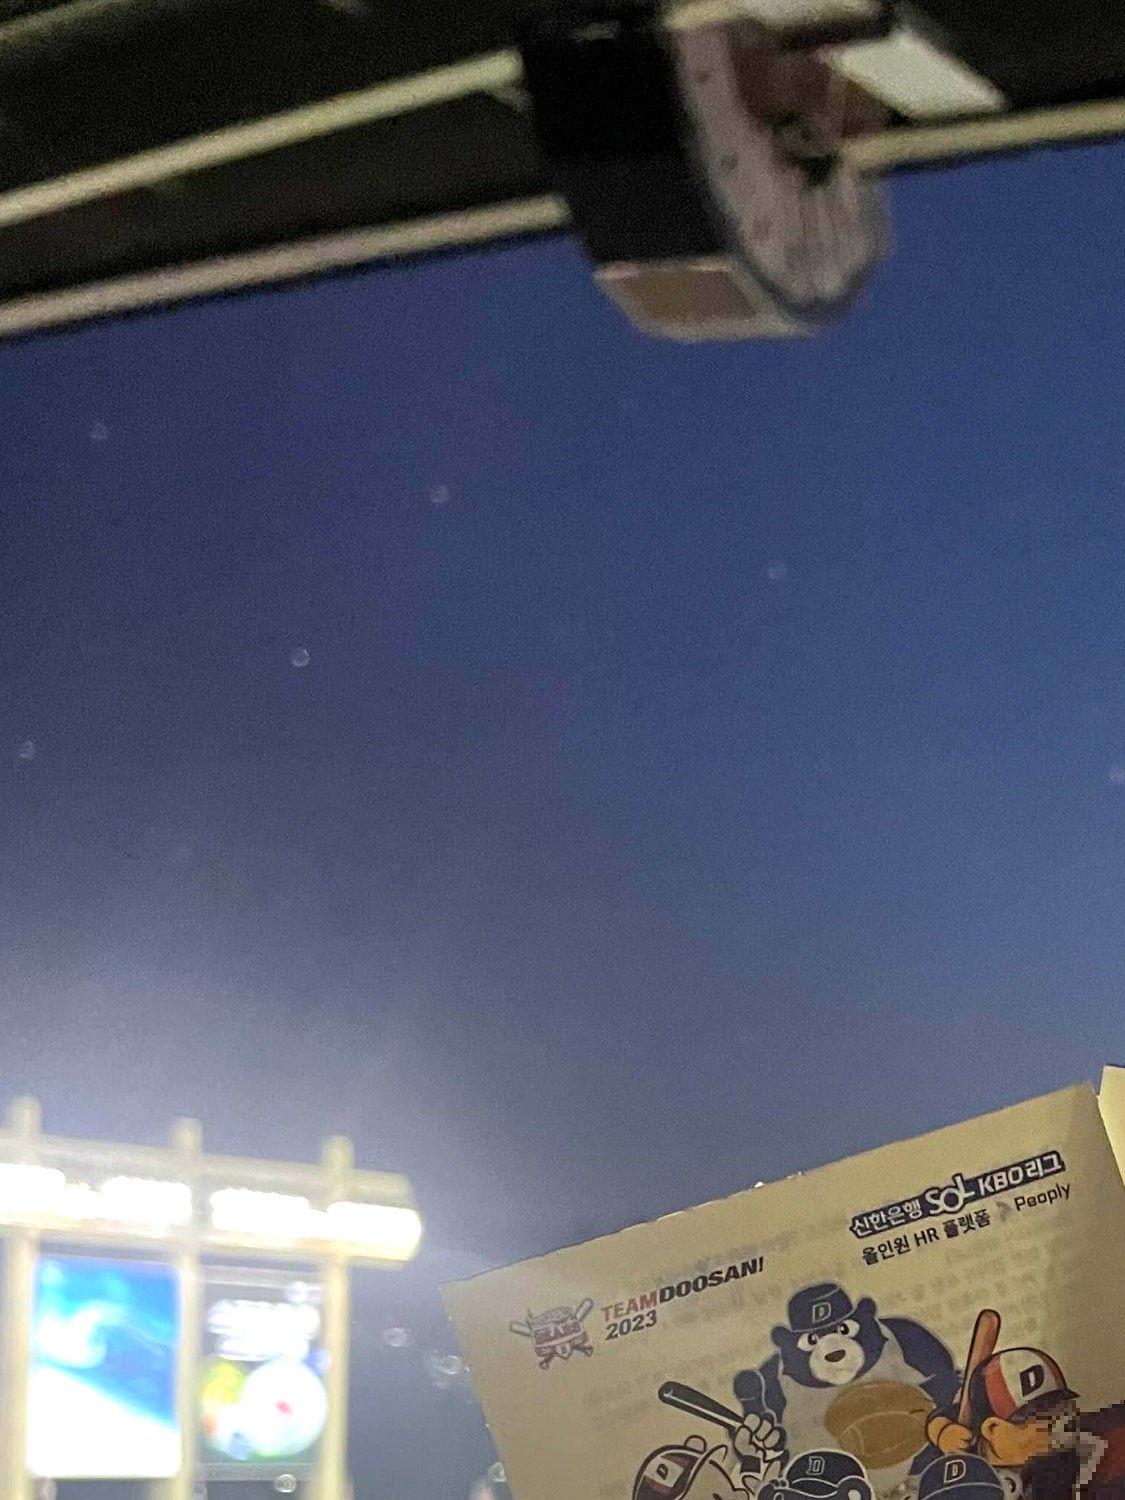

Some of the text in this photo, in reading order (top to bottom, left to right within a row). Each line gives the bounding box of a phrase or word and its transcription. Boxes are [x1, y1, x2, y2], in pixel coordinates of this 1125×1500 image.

[852, 1199, 923, 1237] 신한은행
[862, 1235, 911, 1265] 올인원
[914, 1227, 940, 1248] HR
[943, 1208, 991, 1239] 플랫폼
[605, 1310, 657, 1341] 2023
[811, 1301, 832, 1323] D
[1019, 1364, 1046, 1396] D
[808, 1455, 826, 1476] D
[943, 1458, 967, 1483] D
